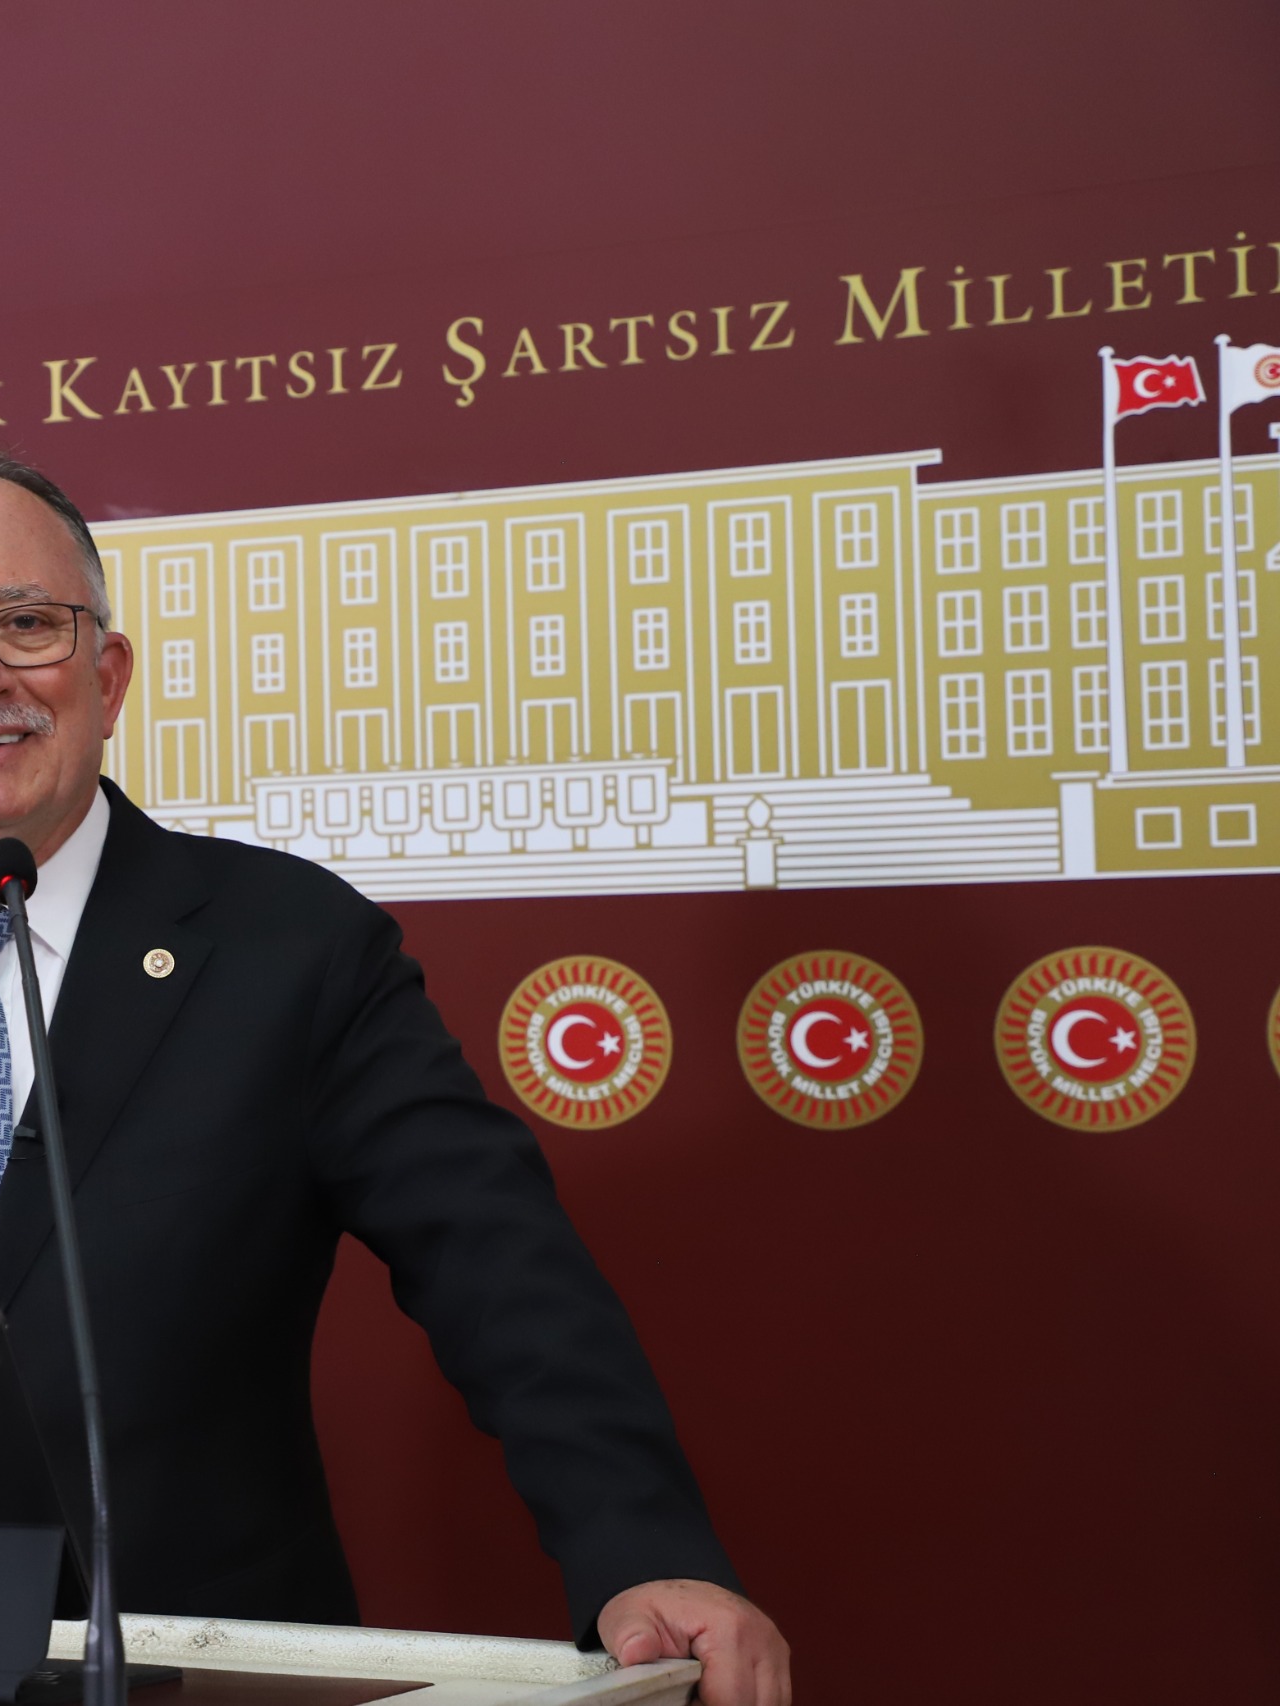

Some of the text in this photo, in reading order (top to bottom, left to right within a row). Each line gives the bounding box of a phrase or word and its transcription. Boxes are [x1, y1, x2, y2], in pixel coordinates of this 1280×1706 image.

[42, 343, 403, 423] KAYITSIZ
[442, 300, 795, 407] ŞARTSIZ
[834, 231, 1280, 345] MİLLETİ
[546, 984, 628, 1013] TÜRKİYE
[786, 980, 875, 1009] TÜRKİYE
[1047, 977, 1144, 1008] TÜRKİYE
[545, 1075, 610, 1101] MİLLET
[791, 1075, 861, 1099] MİLLET
[1051, 1075, 1126, 1102] MİLLET
